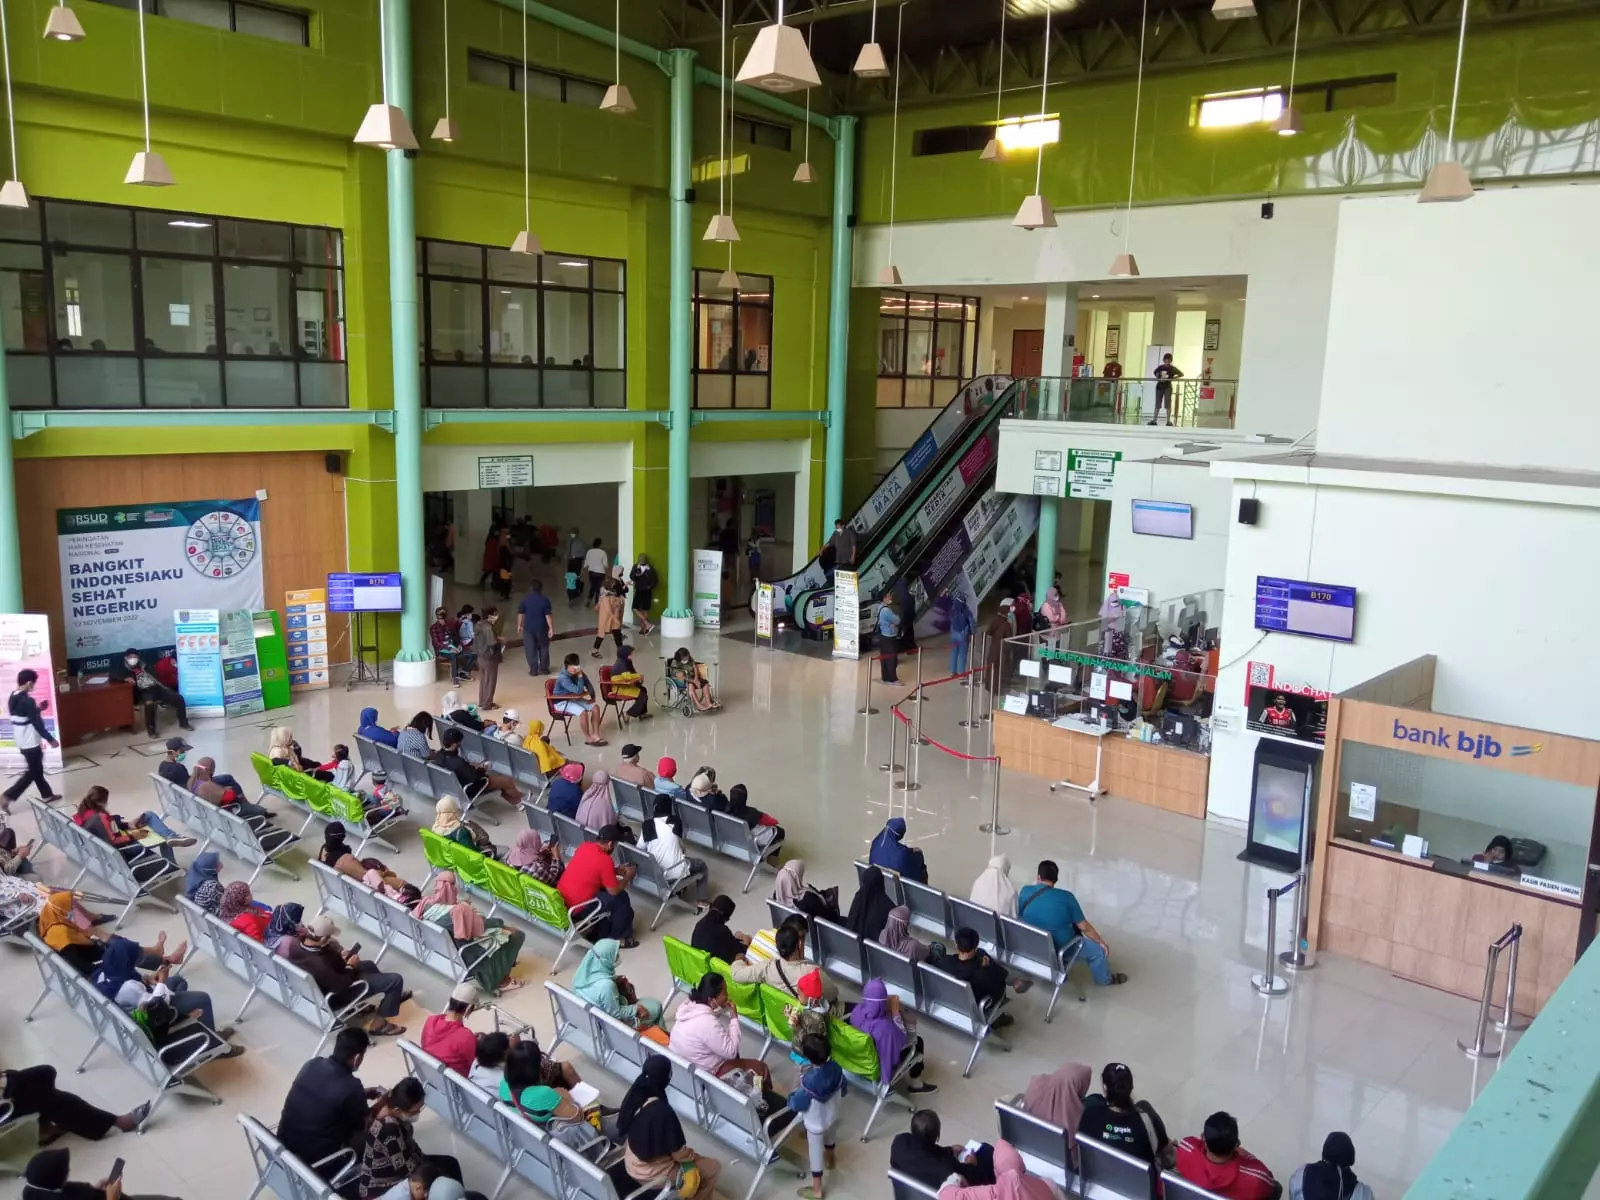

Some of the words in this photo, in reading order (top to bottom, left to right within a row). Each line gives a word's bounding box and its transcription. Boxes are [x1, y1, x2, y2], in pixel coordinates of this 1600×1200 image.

[874, 481, 902, 514] MATA
[75, 513, 109, 523] RSUD
[69, 558, 145, 575] BANGKIT
[70, 568, 184, 589] INDONESIAKU
[71, 587, 127, 603] SEHAT
[1310, 591, 1332, 601] B170
[73, 598, 158, 618] NEGERIKU
[86, 658, 110, 670] RSUD
[1393, 718, 1452, 750] bank
[1457, 730, 1503, 759] bjb
